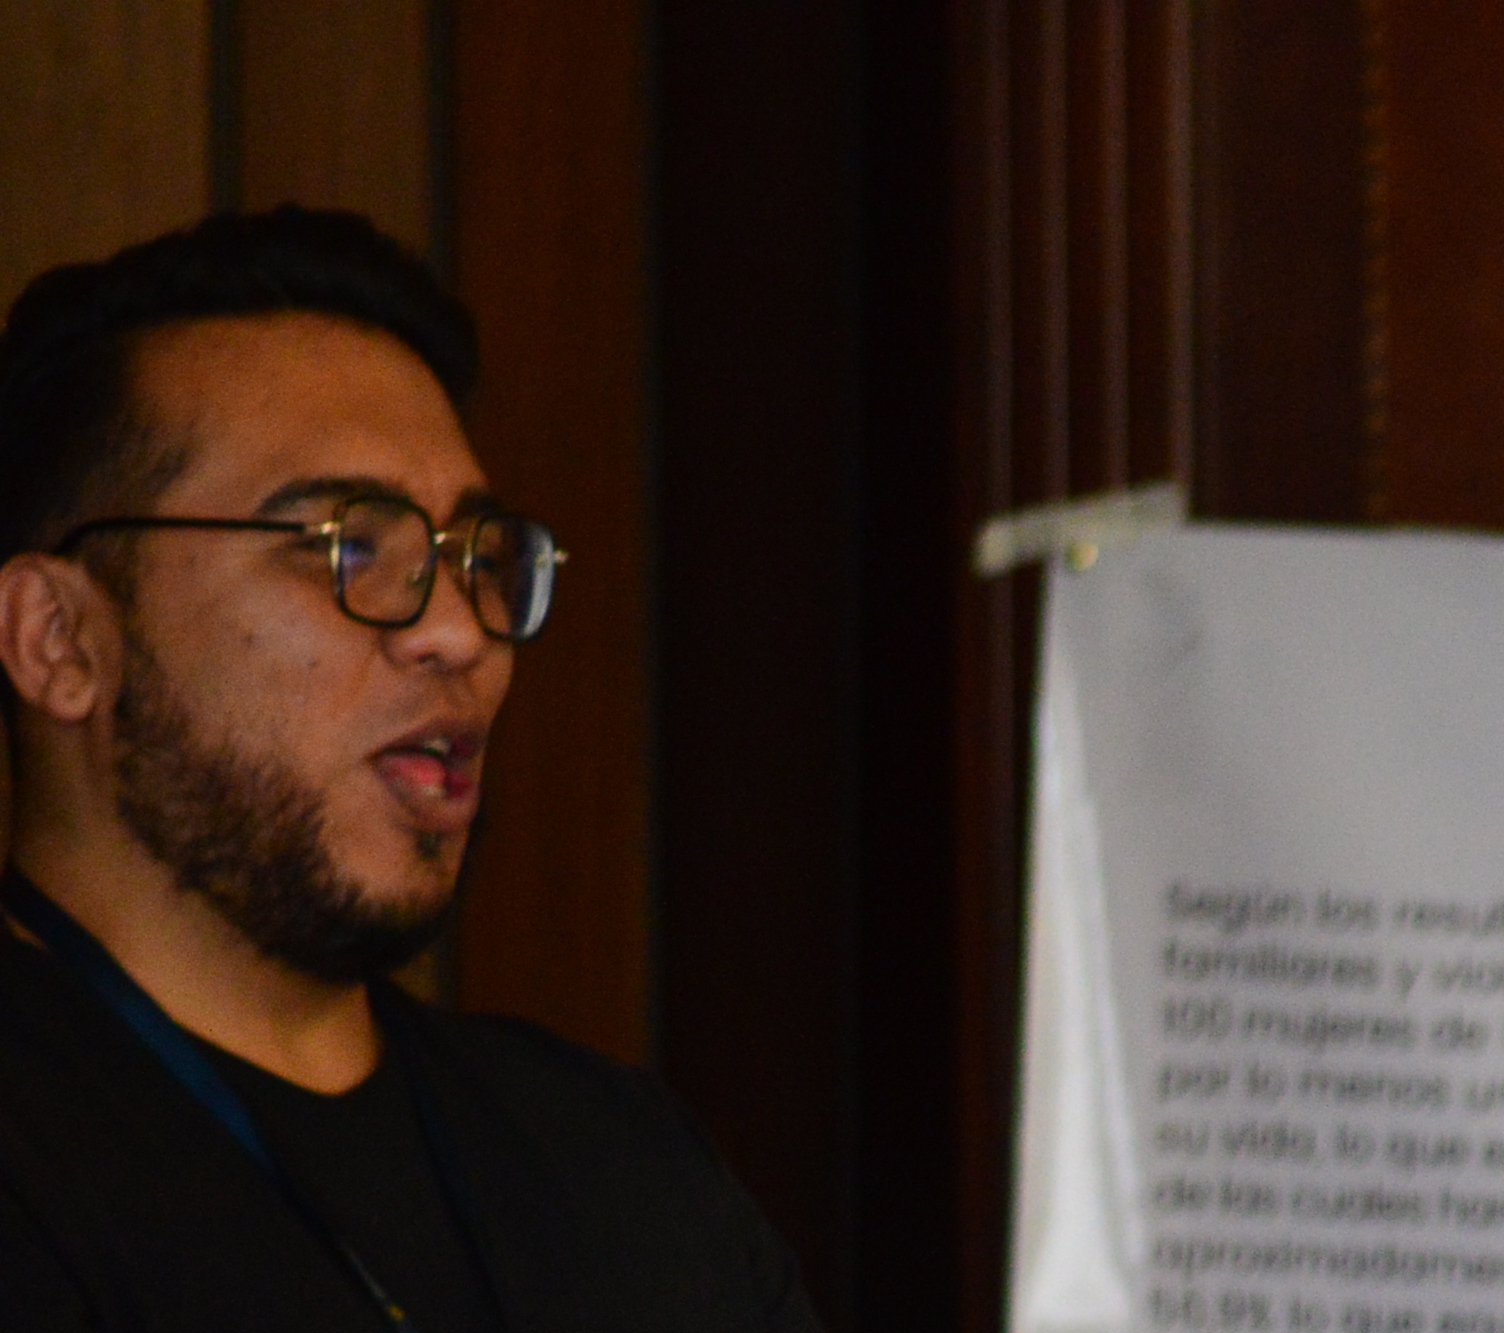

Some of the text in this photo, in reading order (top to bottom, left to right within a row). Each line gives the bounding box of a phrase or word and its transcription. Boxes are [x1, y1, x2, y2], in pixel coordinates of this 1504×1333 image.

[1164, 883, 1302, 934] Según
[1316, 888, 1380, 934] los
[1162, 941, 1378, 990] familiares
[1396, 958, 1417, 995] y
[1243, 1008, 1413, 1051] mujeres
[1432, 1015, 1487, 1053] de
[1157, 1060, 1232, 1105] por
[1246, 1063, 1283, 1102] lo
[1300, 1071, 1450, 1108] menos
[1155, 1120, 1206, 1155] su
[1334, 1124, 1373, 1161] lo
[1387, 1131, 1468, 1173] que
[1153, 1176, 1216, 1215] de
[1221, 1180, 1276, 1217] las
[1290, 1182, 1424, 1222] cuales
